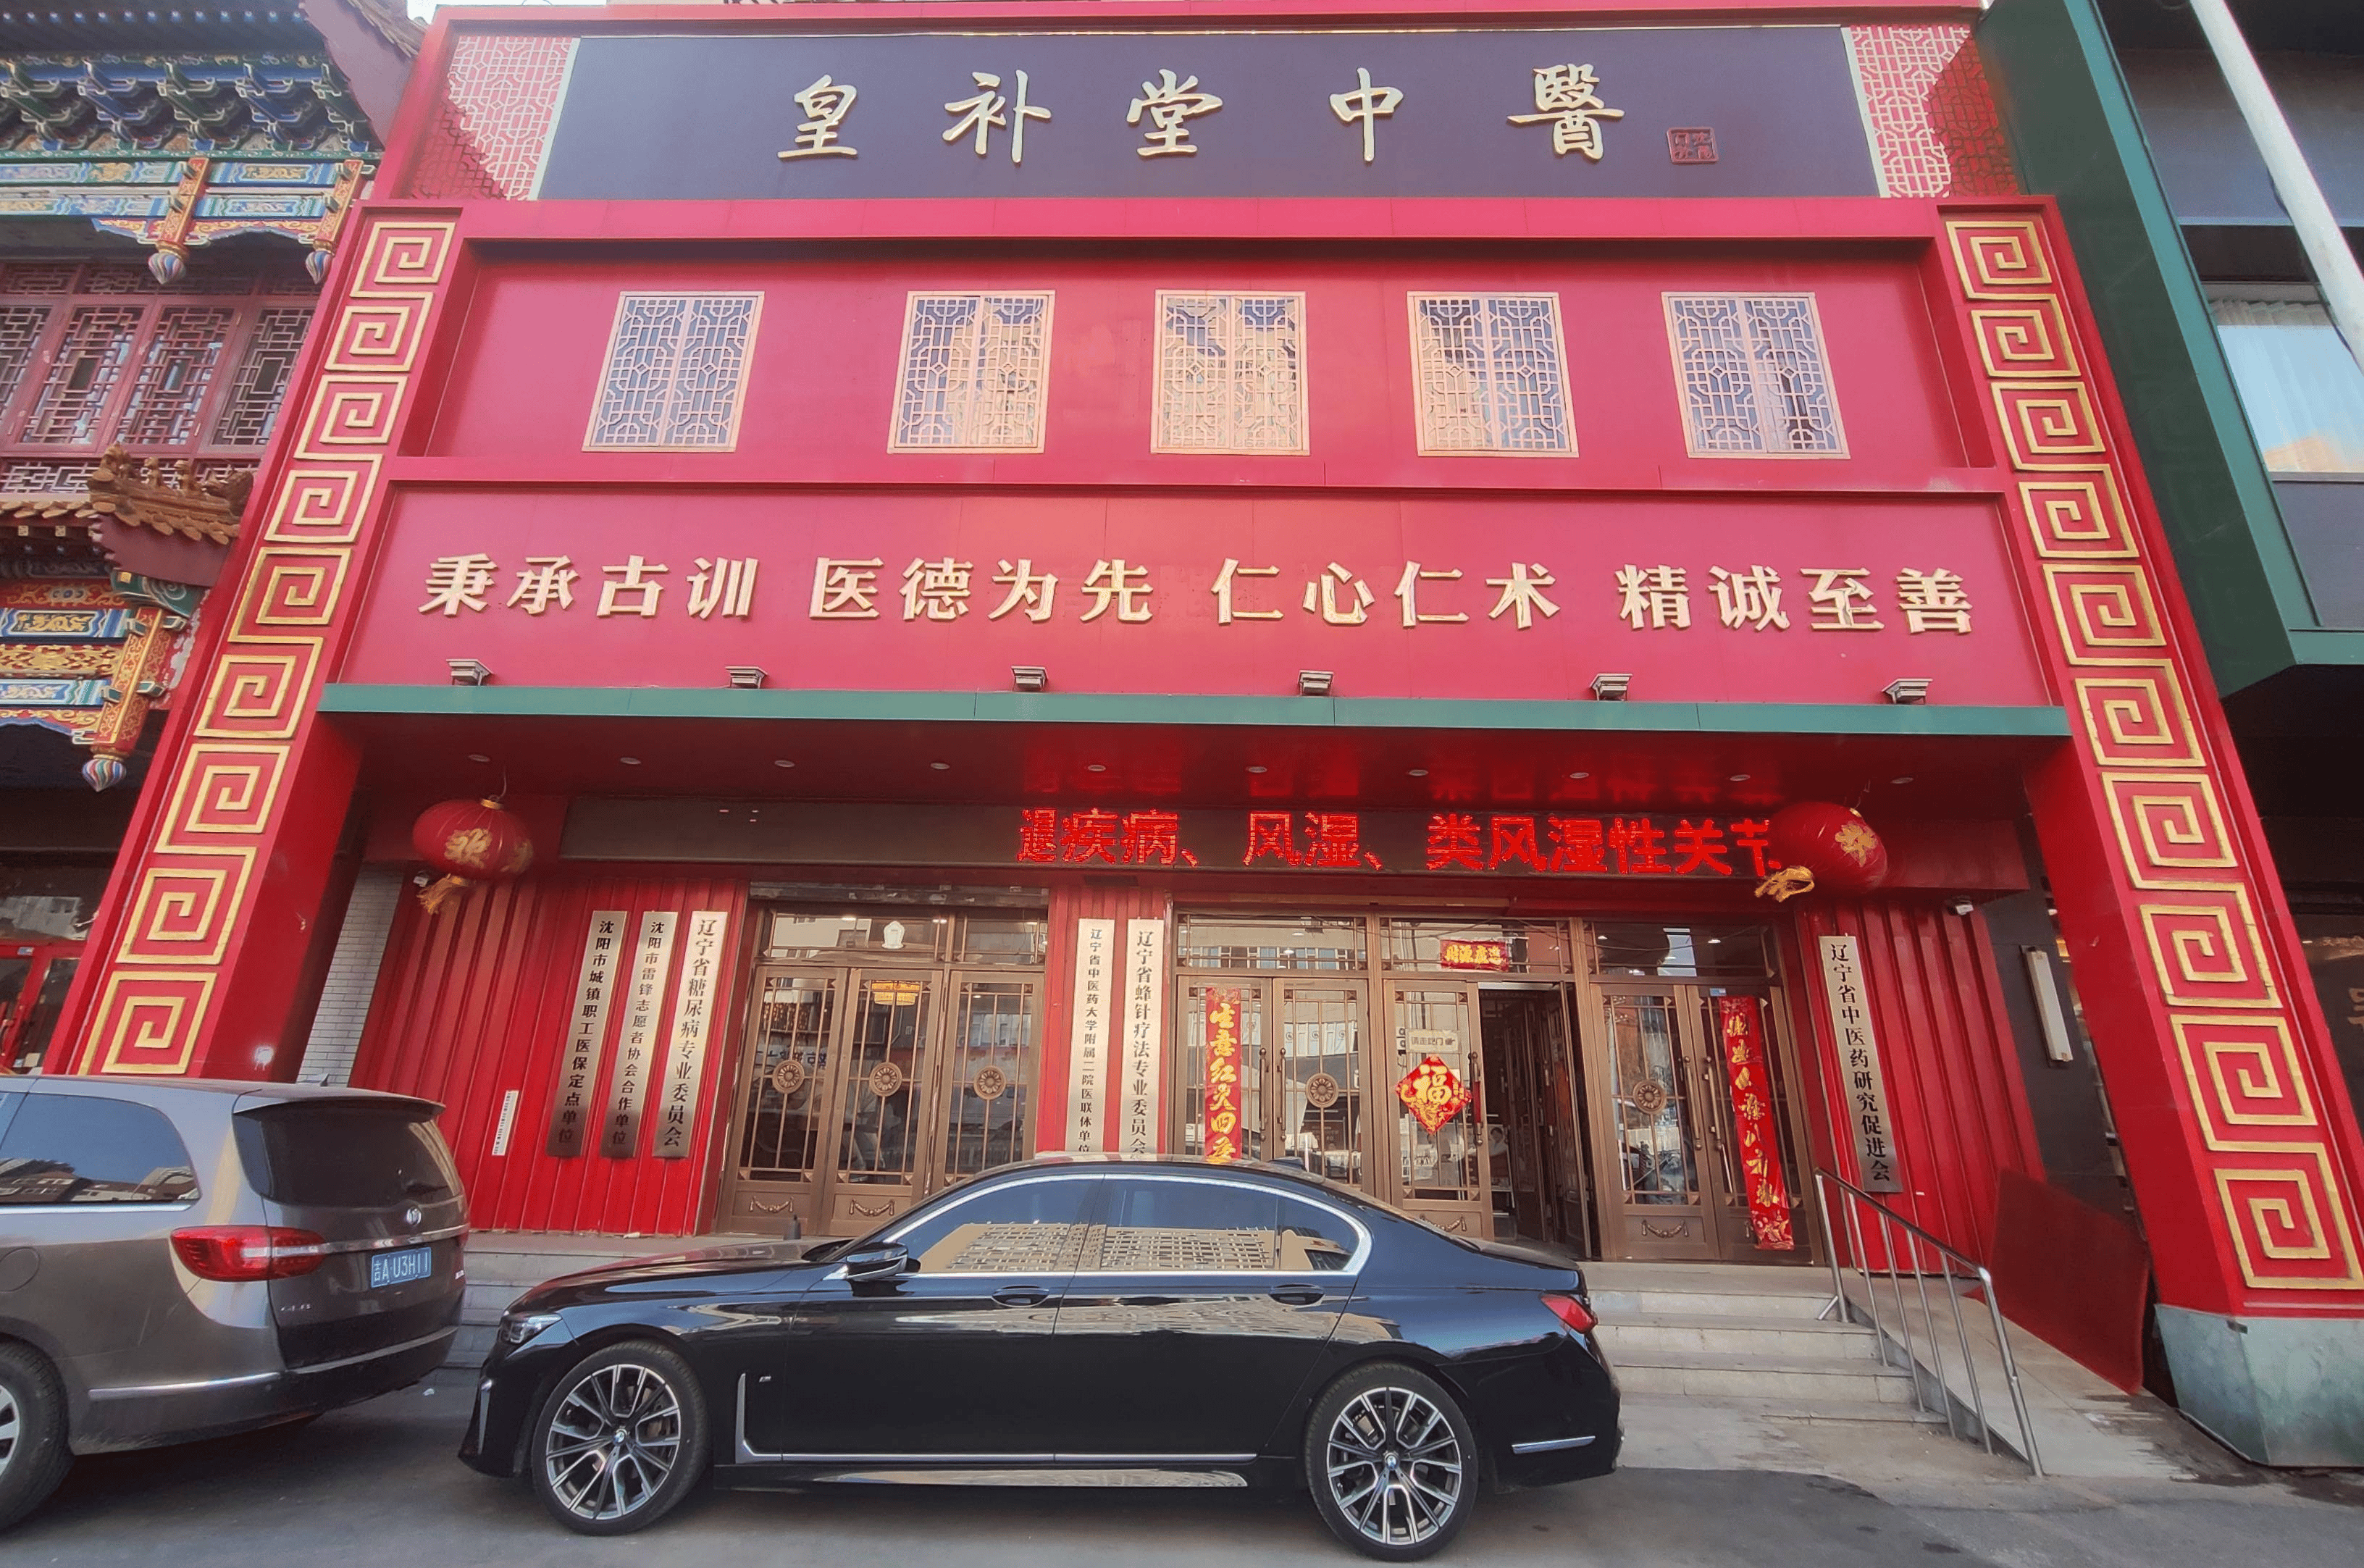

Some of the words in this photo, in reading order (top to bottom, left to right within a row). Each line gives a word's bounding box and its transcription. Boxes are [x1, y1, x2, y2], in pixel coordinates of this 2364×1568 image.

[418, 553, 760, 620] 秉承古训
[808, 555, 1156, 624] 医德为先
[1210, 556, 1561, 629] 仁心仁术
[1615, 563, 1974, 634] 精诚至善
[558, 920, 614, 1144] 沈阳市城镇职工医保定点单位
[612, 921, 664, 1145] 沈阳市雷锋志愿者协会合作单位
[663, 918, 718, 1147] 辽宁省糖尿病专业委员会
[1412, 1064, 1453, 1105] 福
[1829, 943, 1891, 1182] 辽宁省中医药研究促进会
